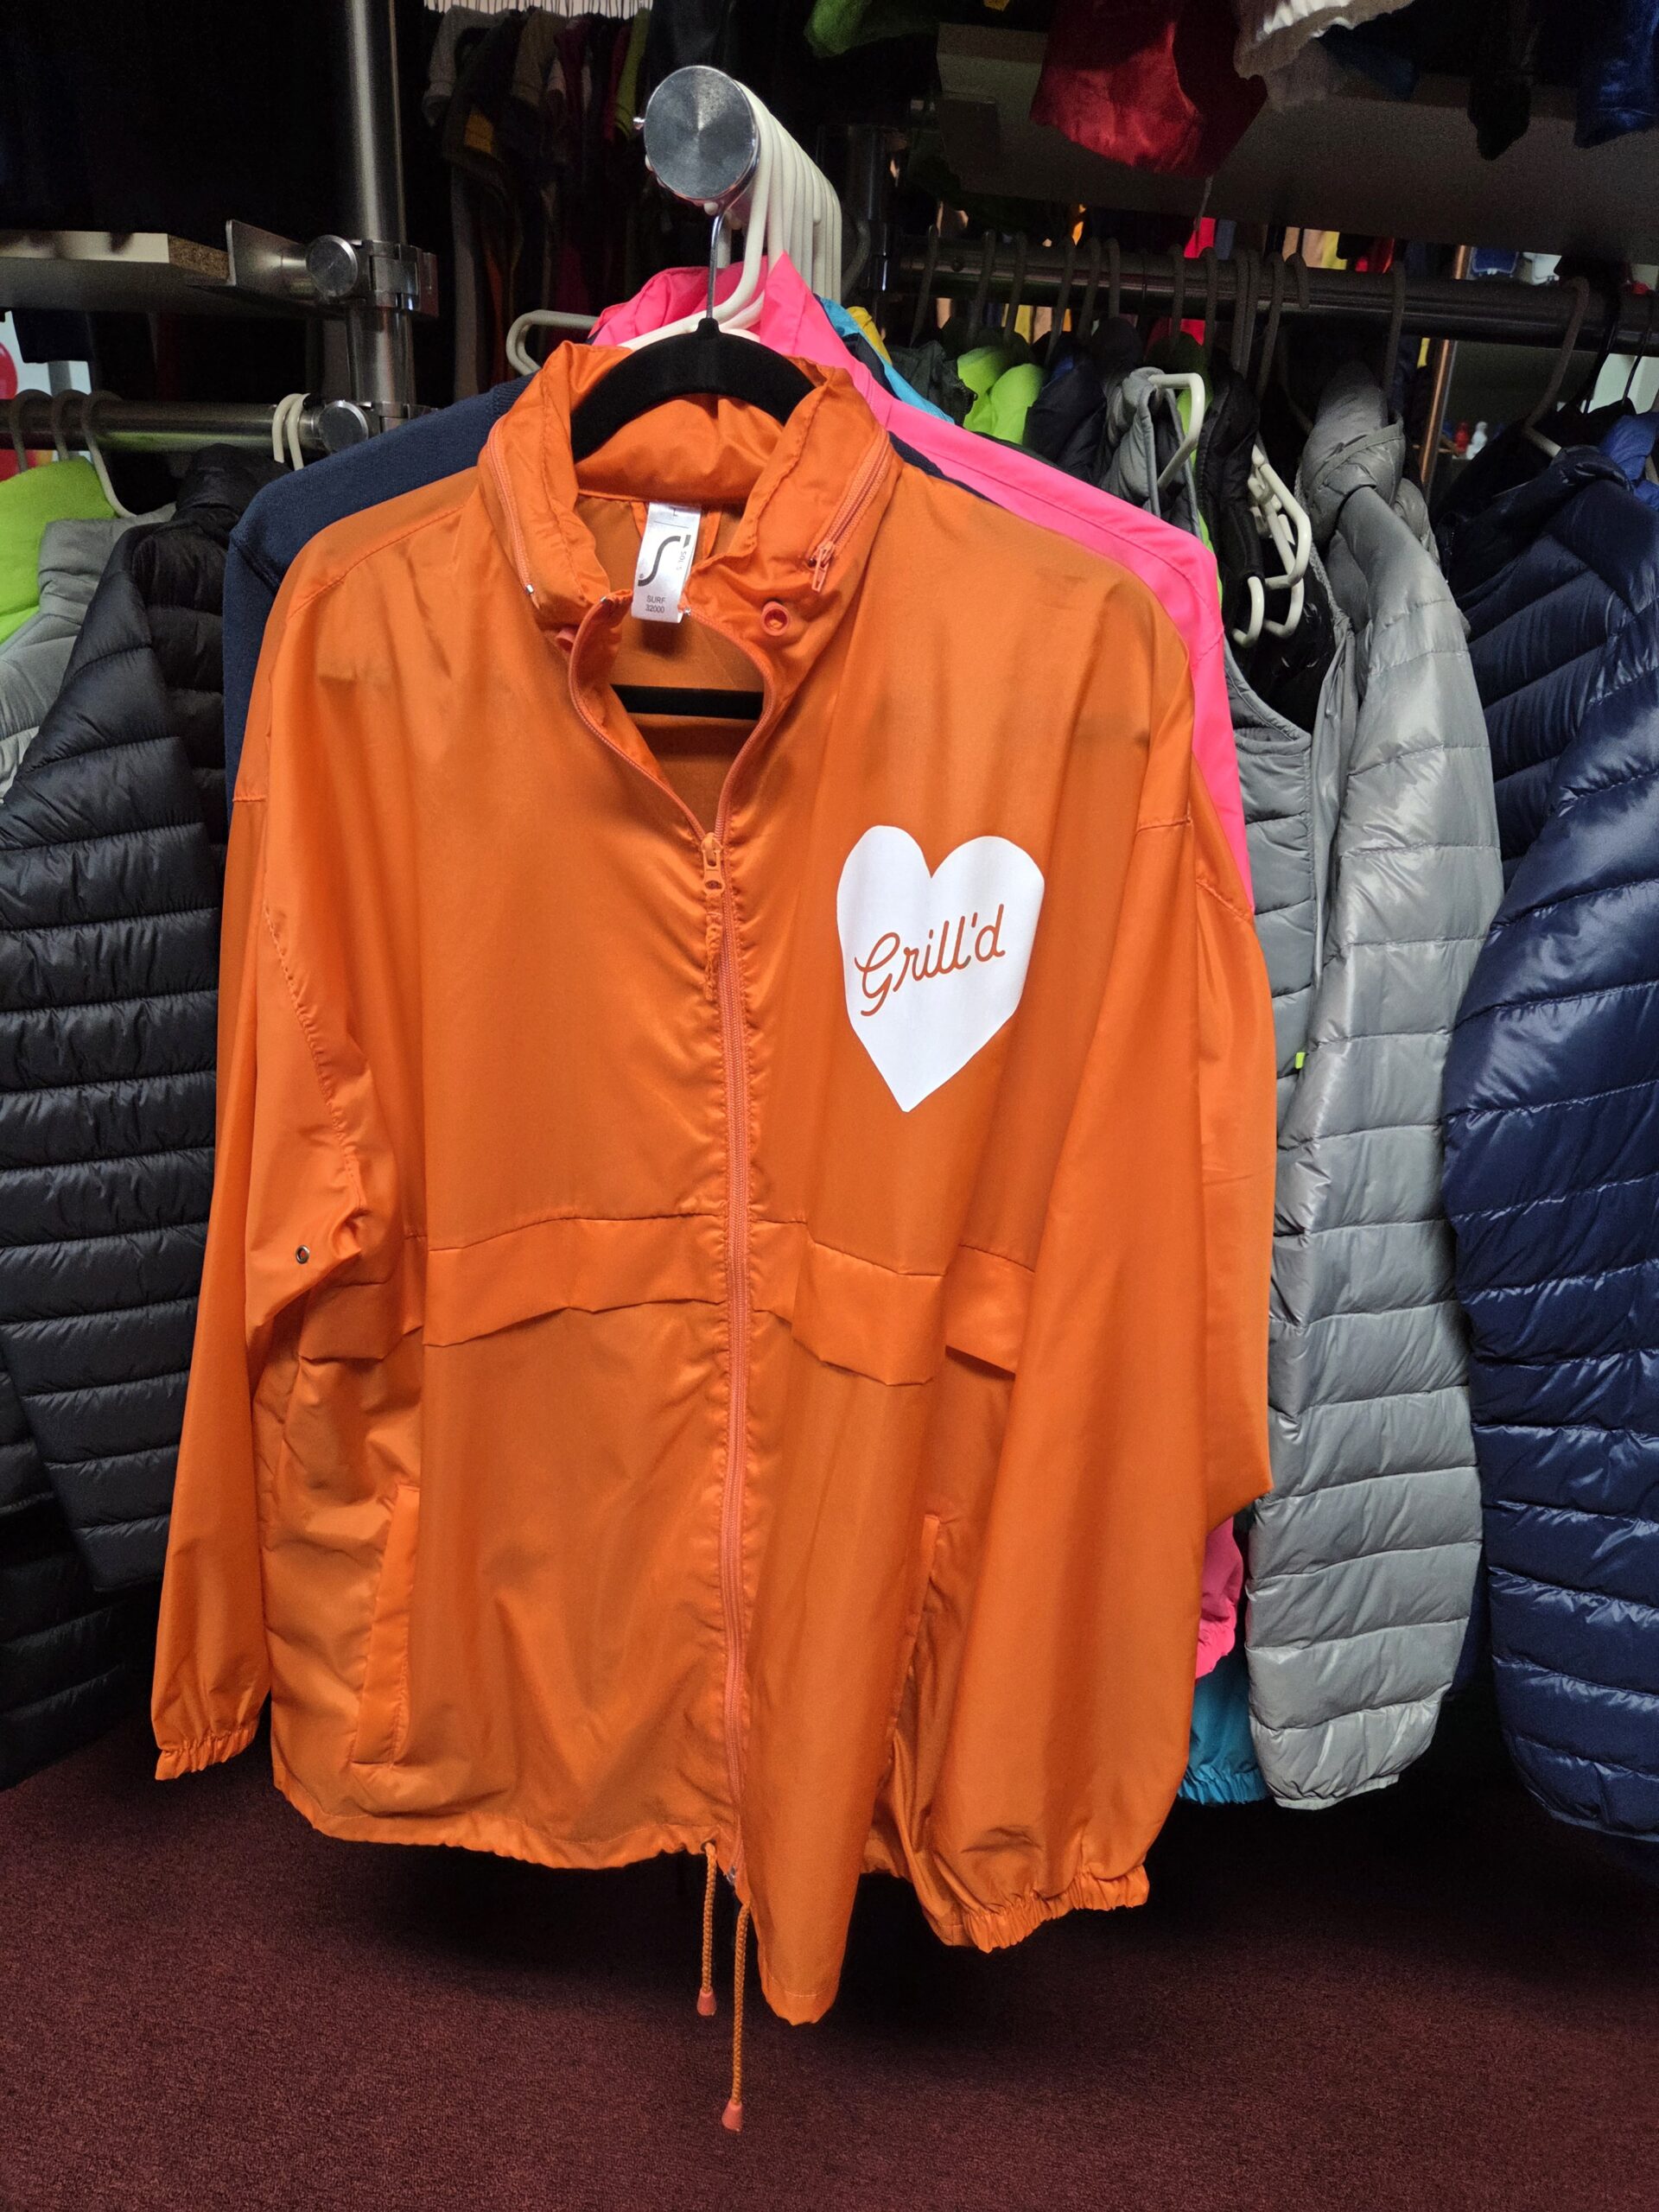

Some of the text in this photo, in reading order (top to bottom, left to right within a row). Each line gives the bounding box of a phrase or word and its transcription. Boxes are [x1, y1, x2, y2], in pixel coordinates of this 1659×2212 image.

[646, 594, 665, 604] SURF
[645, 604, 665, 613] 32000
[854, 904, 1006, 1016] Grill'd
